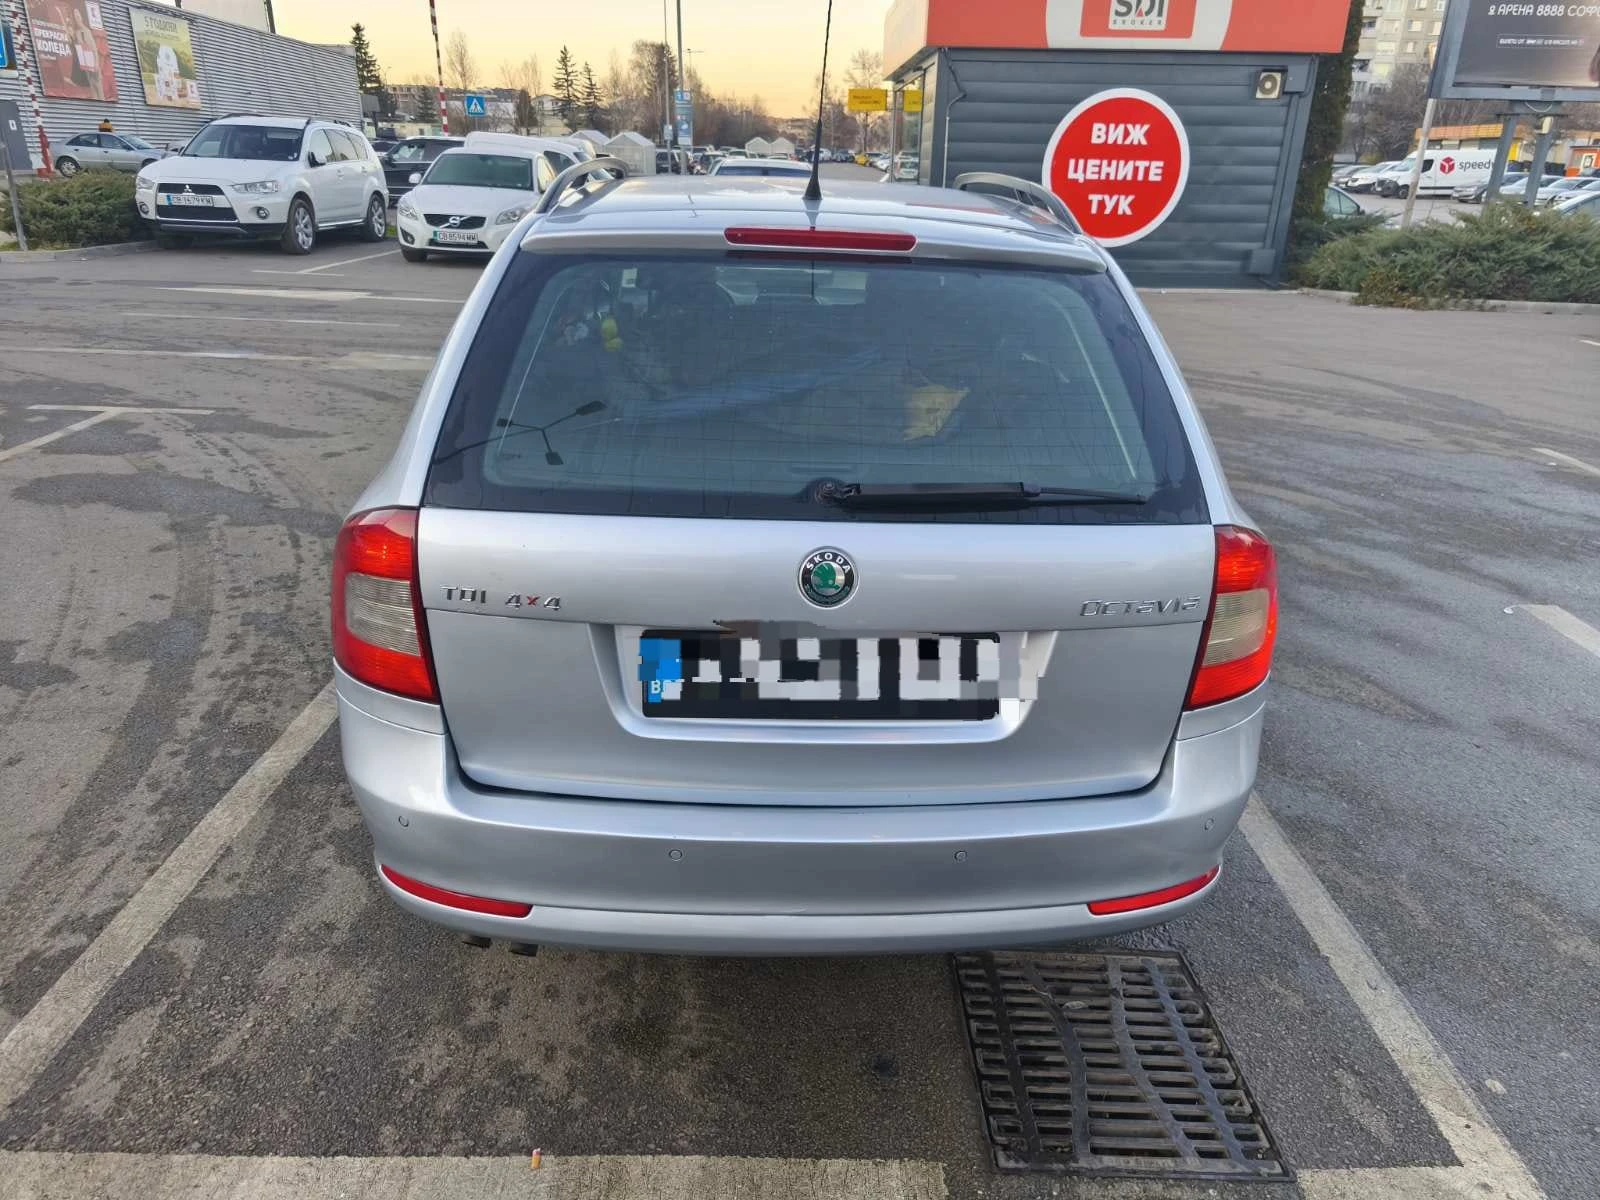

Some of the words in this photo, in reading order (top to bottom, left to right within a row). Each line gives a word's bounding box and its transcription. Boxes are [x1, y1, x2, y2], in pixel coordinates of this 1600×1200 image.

[1114, 0, 1165, 17] SDI
[1497, 4, 1534, 16] АРЕНА
[1536, 5, 1565, 16] 8888
[1091, 123, 1151, 145] ВИЖ
[1067, 158, 1164, 183] ЦЕНИТЕ
[1088, 194, 1135, 215] ТУК
[440, 585, 487, 604] TDI
